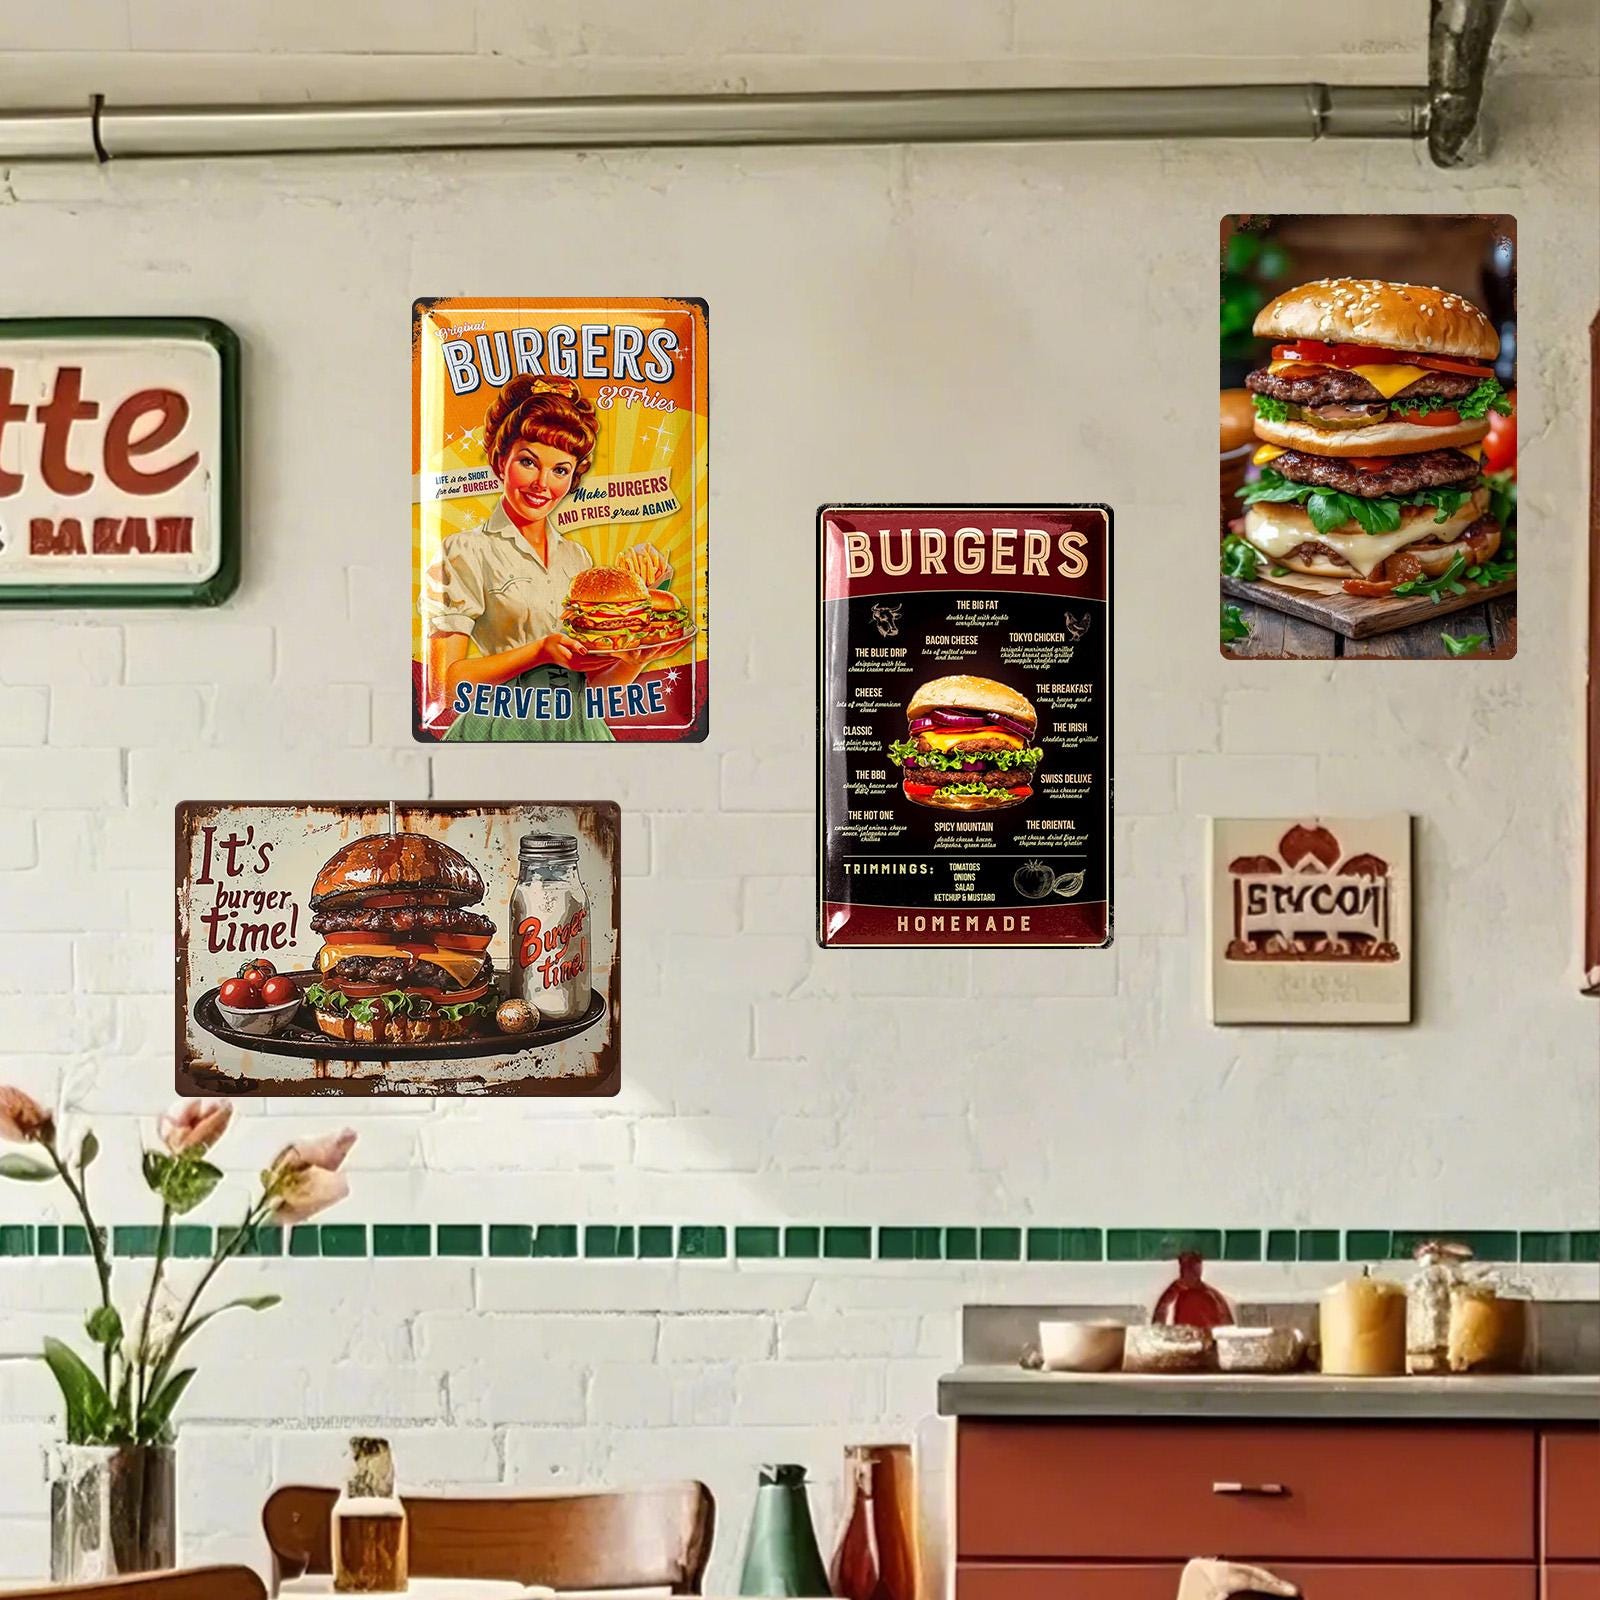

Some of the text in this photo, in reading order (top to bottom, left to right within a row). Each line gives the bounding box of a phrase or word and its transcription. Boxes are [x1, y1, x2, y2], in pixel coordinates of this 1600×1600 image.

[435, 320, 486, 342] Original
[442, 324, 679, 396] BURGERS
[597, 386, 678, 414] & Fries
[435, 474, 449, 485] LIFE
[468, 470, 489, 481] SHORT
[463, 479, 500, 493] BURGERS
[572, 476, 669, 503] Make BURGERS
[557, 498, 678, 526] AND FRIES great AGAIN!
[844, 527, 1089, 579] BURGERS
[957, 600, 998, 610] THE BIG FAT
[926, 635, 978, 645] BACON CHEESE
[1009, 632, 1065, 642] TOKYO CHICKEN
[856, 648, 907, 657] THE BLUE DRIP
[855, 688, 883, 697] CHEESE
[1036, 684, 1093, 693] THE BREAKFAST
[453, 680, 667, 721] SERVED HERE
[843, 726, 872, 735] CLASSIC
[1053, 723, 1088, 732] THE IRISH
[856, 770, 886, 780] THE BBQ
[1041, 774, 1092, 784] SWISS DELUXE
[848, 811, 894, 820] THE HOT ONE
[934, 822, 993, 832] SPICY MOUNTAIN
[1026, 820, 1075, 830] THE ORIENTAL
[196, 825, 274, 885] It's
[844, 863, 934, 874] TRIMMINGS:
[949, 863, 980, 872] TOMATOES
[954, 873, 975, 882] ONIONS
[955, 883, 974, 891] SALAD
[215, 881, 292, 914] burger
[934, 893, 995, 902] KETCHUP & MUSTARD
[200, 903, 299, 953] time!
[897, 916, 1031, 932] HOMEMADE
[517, 907, 587, 969] Burger
[537, 936, 586, 990] time!
